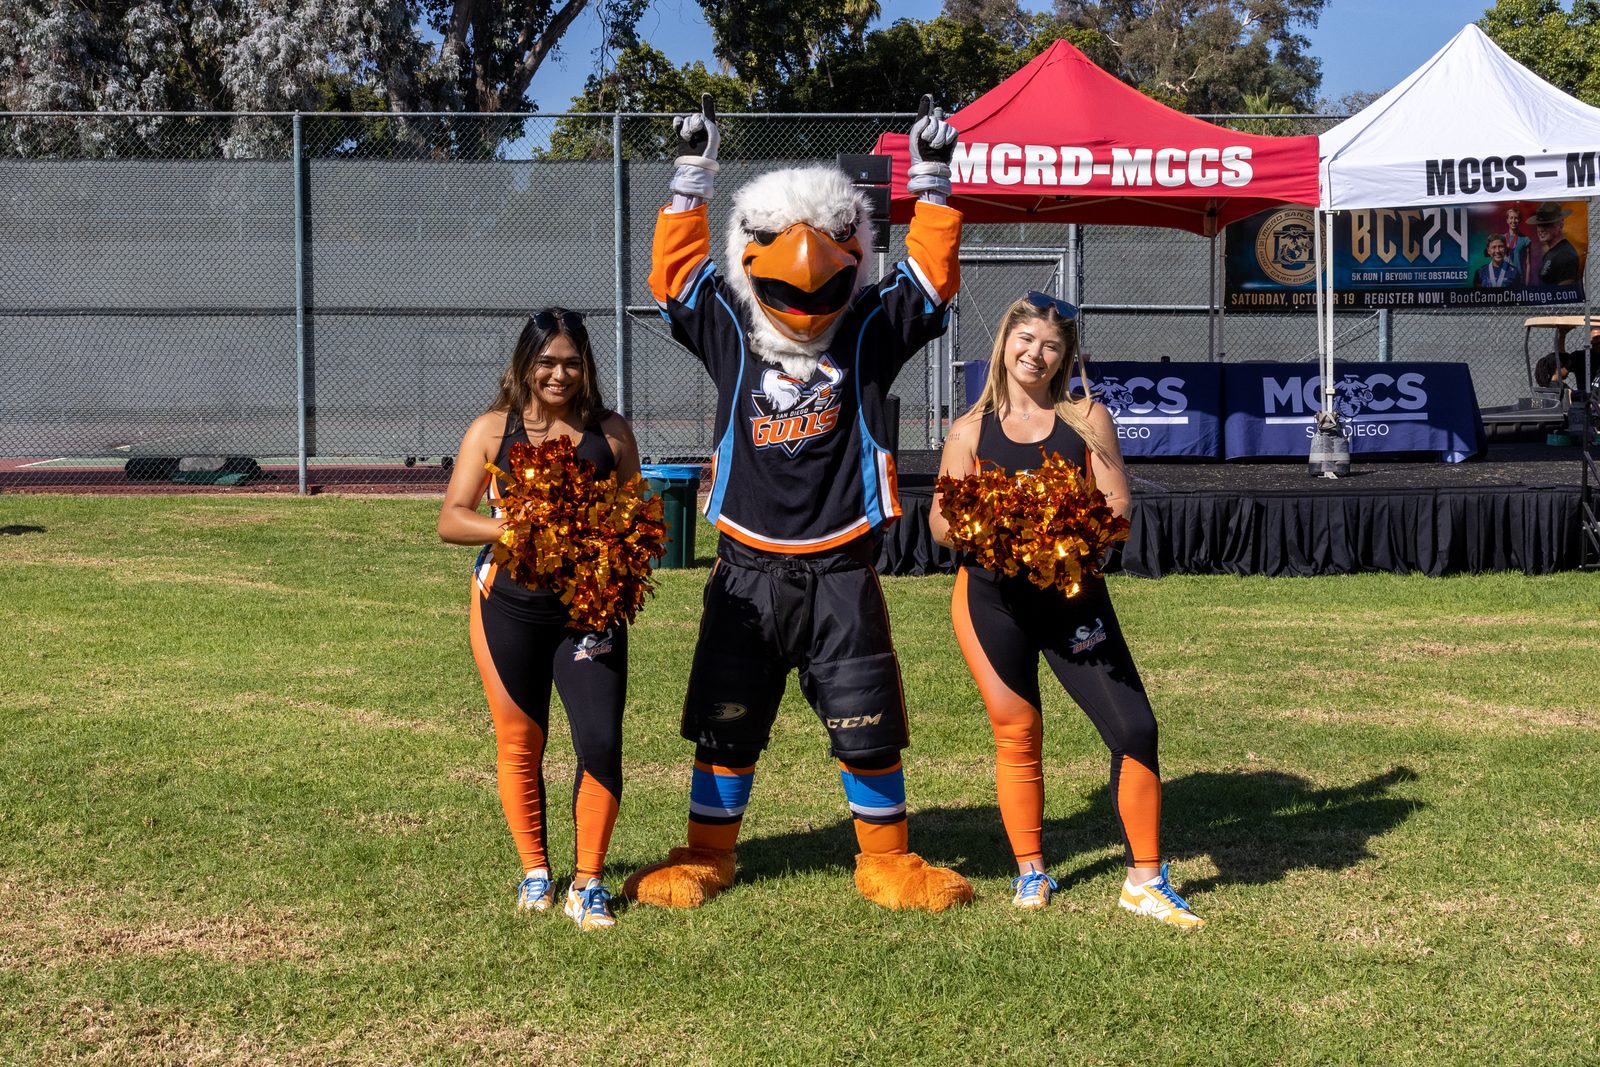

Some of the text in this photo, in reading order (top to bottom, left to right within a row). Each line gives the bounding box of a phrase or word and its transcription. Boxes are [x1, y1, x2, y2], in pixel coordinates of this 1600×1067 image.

[951, 142, 1253, 187] MCRD-MCCS
[1426, 155, 1527, 196] MCCS
[1566, 152, 1600, 188] M
[1262, 214, 1283, 237] MCRD
[1350, 207, 1468, 263] BCC24
[1351, 272, 1361, 281] 5K
[1362, 272, 1378, 281] RUN
[1384, 272, 1412, 281] BEYOND
[1413, 272, 1427, 280] THE
[1428, 271, 1468, 280] OBSTACLES
[1231, 293, 1289, 306] SATURDAY,
[1343, 292, 1355, 305] 19
[1364, 292, 1415, 305] REGISTER
[1418, 292, 1445, 304] NOW!
[1449, 290, 1578, 304] BootCampChallenge.com
[1262, 372, 1428, 414] MCCS
[790, 408, 809, 417] DIEGO
[750, 404, 841, 446] GULLS
[1117, 427, 1151, 439] EGO
[826, 713, 882, 728] CCM
